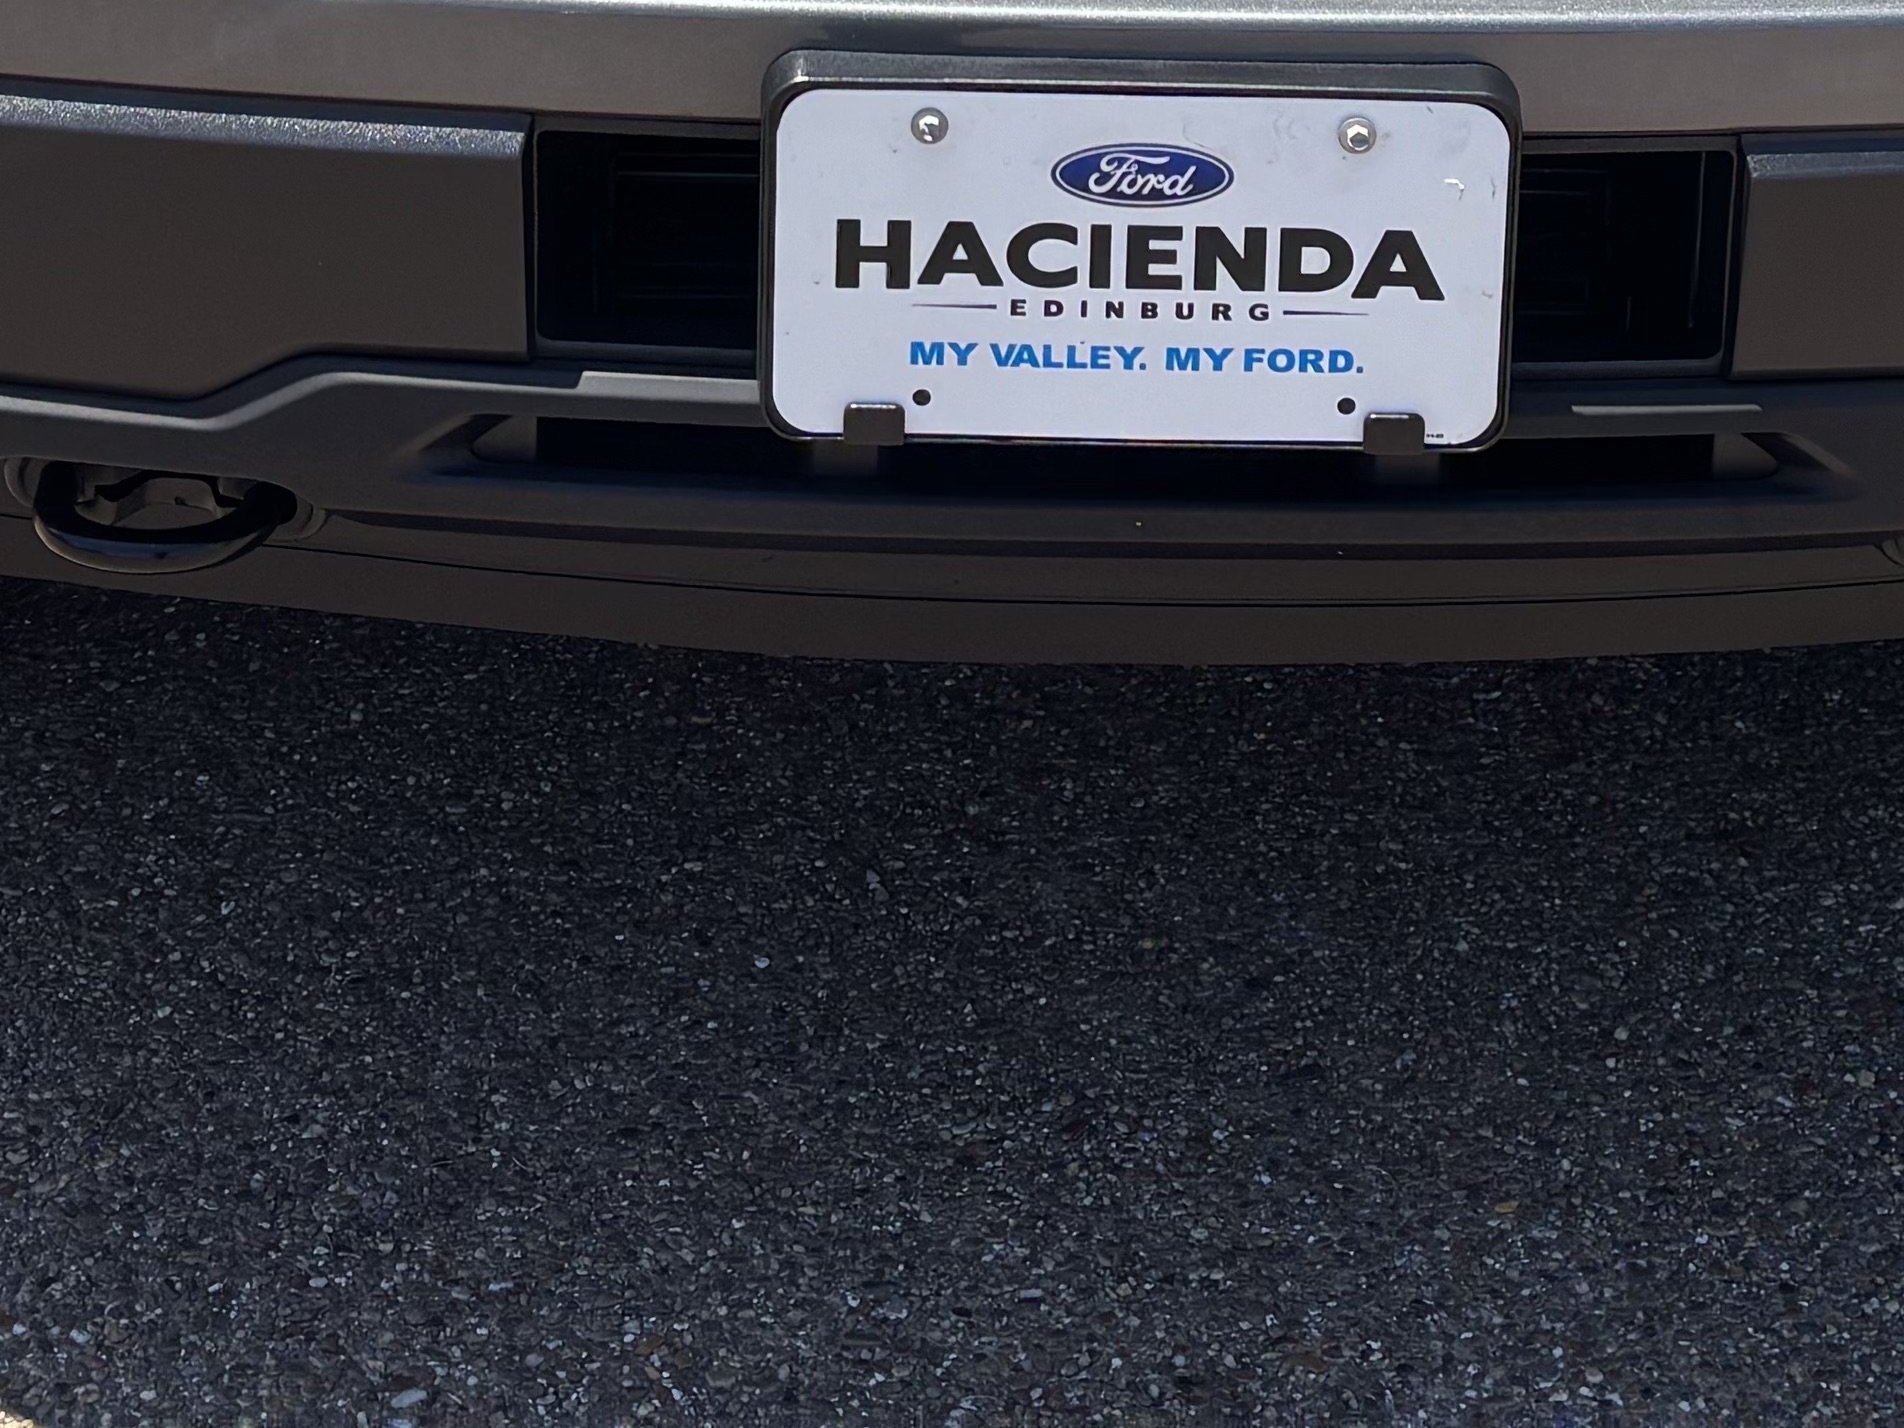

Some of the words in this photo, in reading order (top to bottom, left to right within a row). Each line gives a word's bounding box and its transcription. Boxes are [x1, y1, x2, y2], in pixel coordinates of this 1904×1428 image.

[1088, 153, 1197, 196] Ford
[834, 218, 1446, 301] HACIENDA
[1010, 299, 1270, 322] EDINBURG
[910, 341, 978, 366] MY
[989, 342, 1147, 371] VALLEY.
[1165, 347, 1234, 372] MY
[1243, 348, 1365, 374] FORD.
